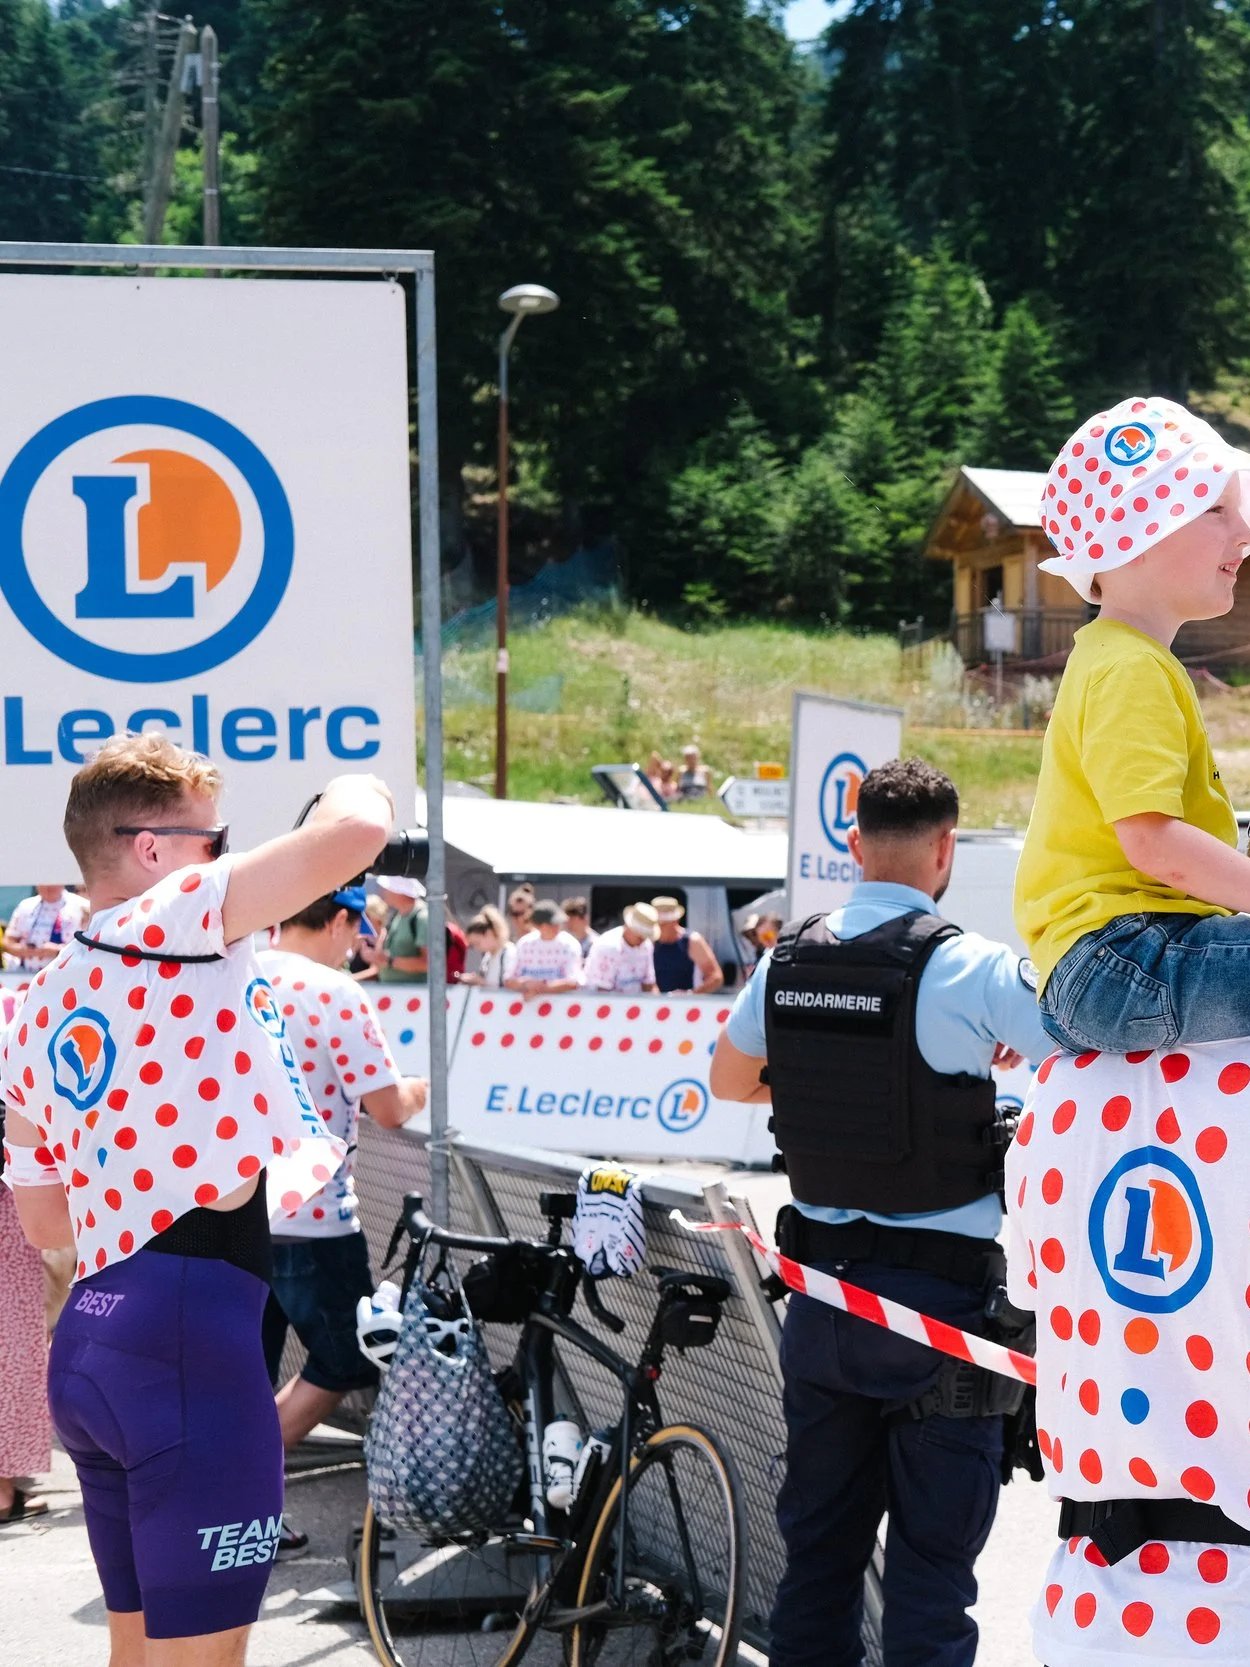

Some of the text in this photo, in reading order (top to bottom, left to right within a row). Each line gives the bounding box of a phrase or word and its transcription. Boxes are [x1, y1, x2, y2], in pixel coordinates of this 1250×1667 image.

[73, 475, 195, 619] L
[774, 990, 882, 1012] GENDARMERIE
[486, 1085, 652, 1119] E.Leclerc
[74, 1288, 126, 1317] BEST
[197, 1512, 283, 1550] TEAM
[211, 1537, 280, 1572] BEST
